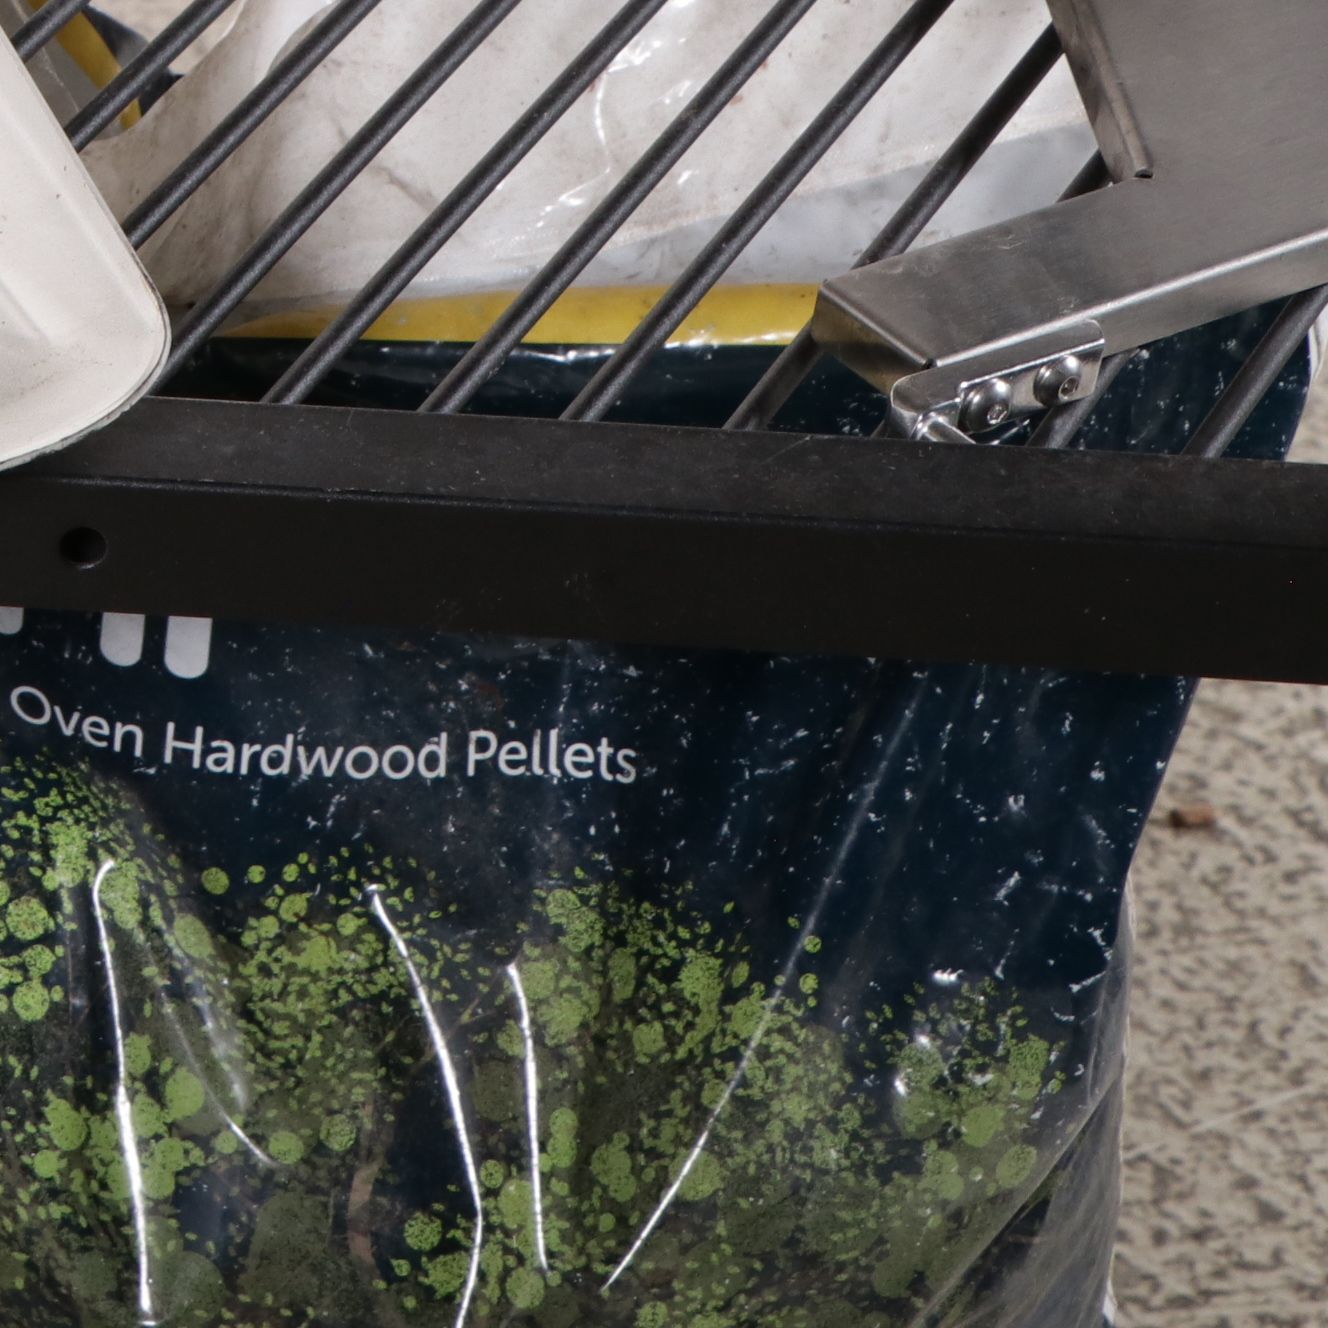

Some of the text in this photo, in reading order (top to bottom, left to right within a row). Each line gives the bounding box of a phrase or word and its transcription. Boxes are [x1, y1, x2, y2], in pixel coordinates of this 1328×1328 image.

[9, 684, 144, 757] Oven
[162, 722, 447, 780] Hardwood
[466, 728, 637, 784] Pellets
